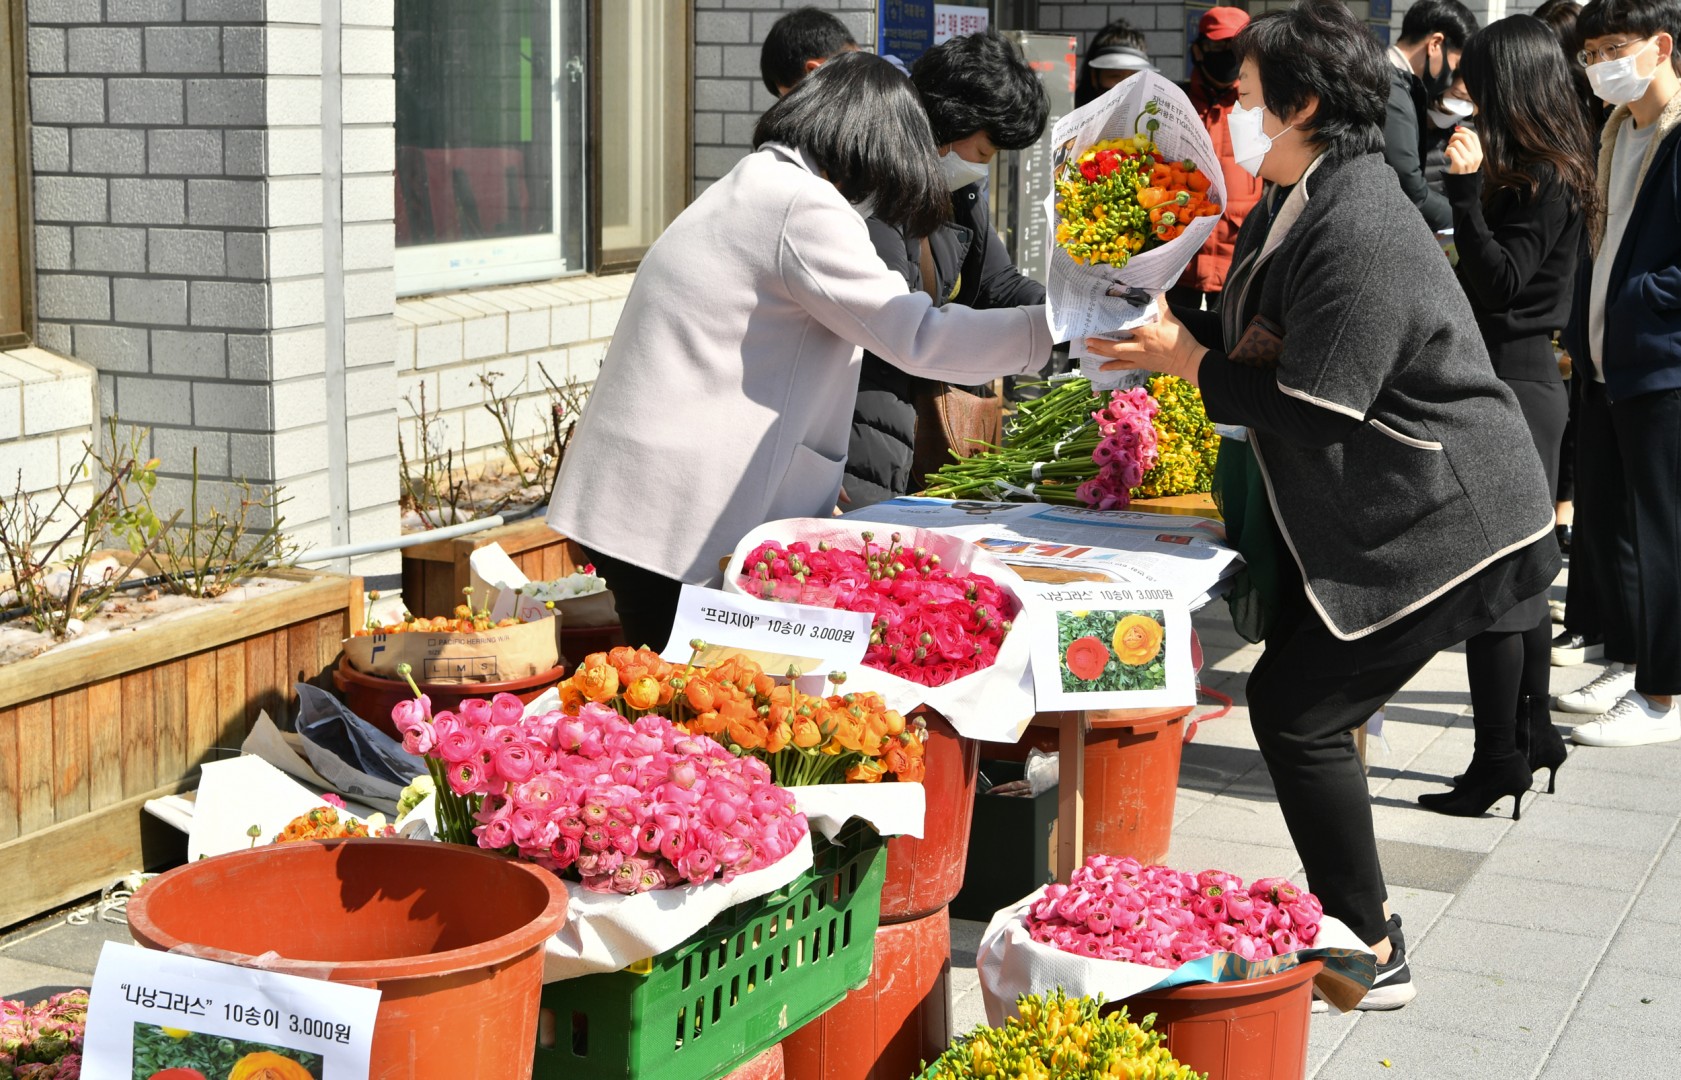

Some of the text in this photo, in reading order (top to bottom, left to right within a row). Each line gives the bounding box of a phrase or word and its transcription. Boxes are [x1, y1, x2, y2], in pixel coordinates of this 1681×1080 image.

[1171, 104, 1184, 116] ETF
[1100, 590, 1134, 601] 10송이
[701, 607, 855, 643] “프리지아” 10송이 3,000원
[438, 638, 465, 646] PACIFIC
[466, 637, 497, 645] HERRING
[433, 662, 488, 673] L M S
[121, 983, 352, 1045] “나낭그라스” 10송이 3,000원
